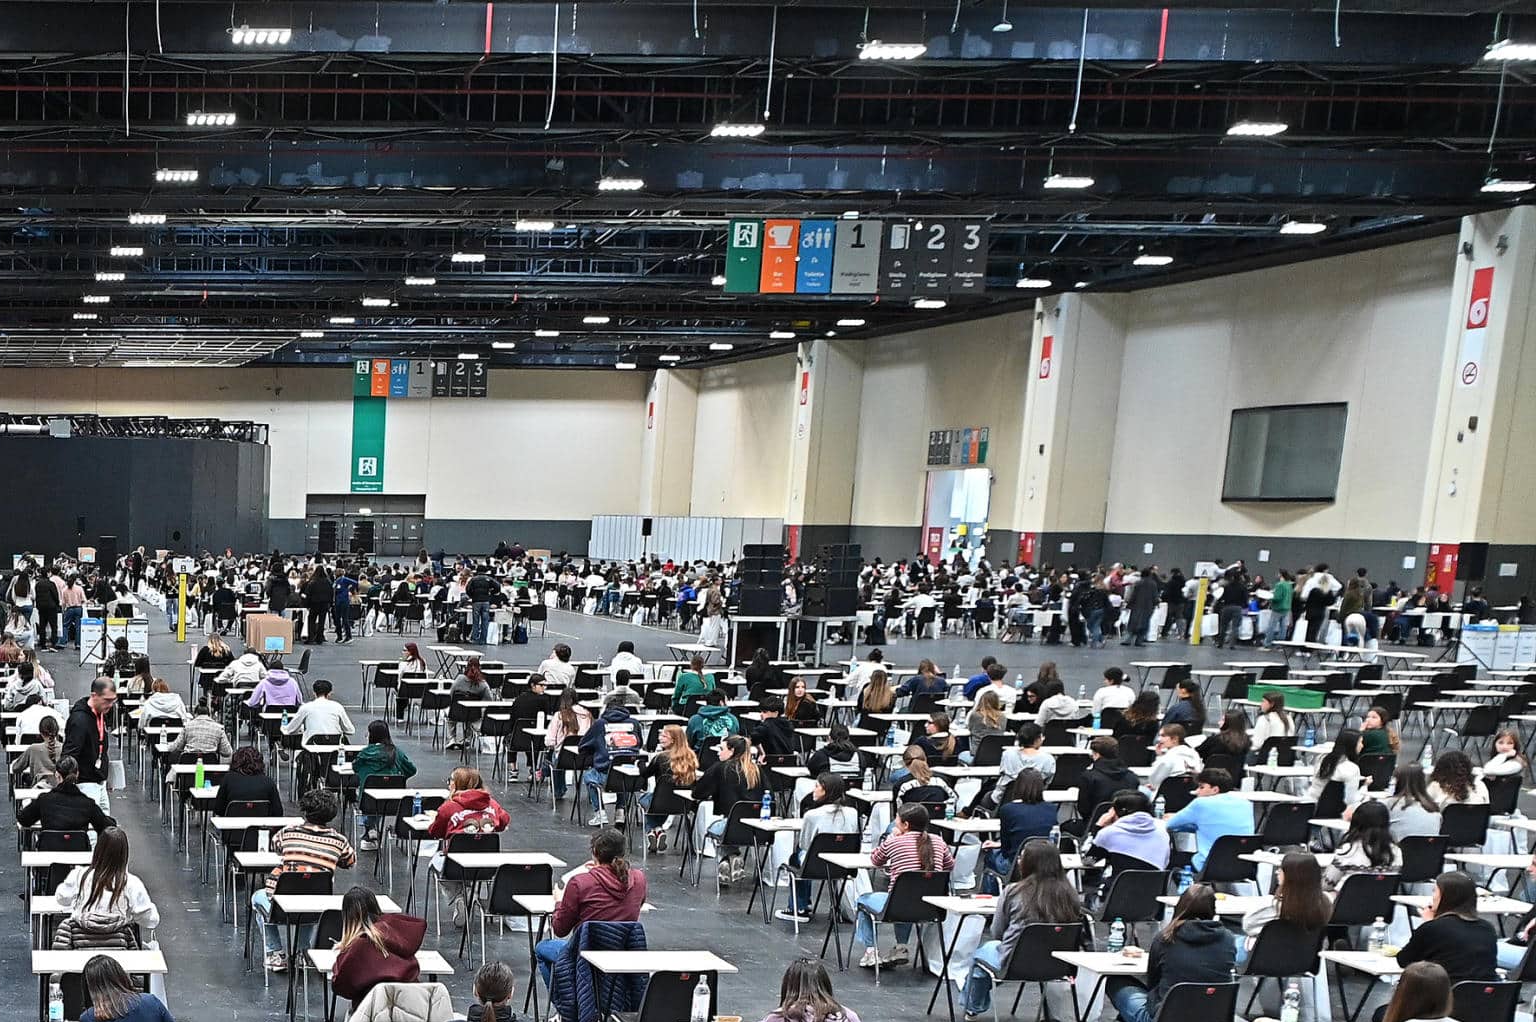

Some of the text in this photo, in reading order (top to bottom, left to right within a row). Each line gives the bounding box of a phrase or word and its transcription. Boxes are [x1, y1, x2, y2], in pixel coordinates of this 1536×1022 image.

[851, 223, 865, 249] 1
[927, 224, 945, 250] 2
[964, 224, 981, 250] 3
[416, 362, 424, 375] 1
[455, 362, 465, 375] 2
[474, 362, 483, 376] 3
